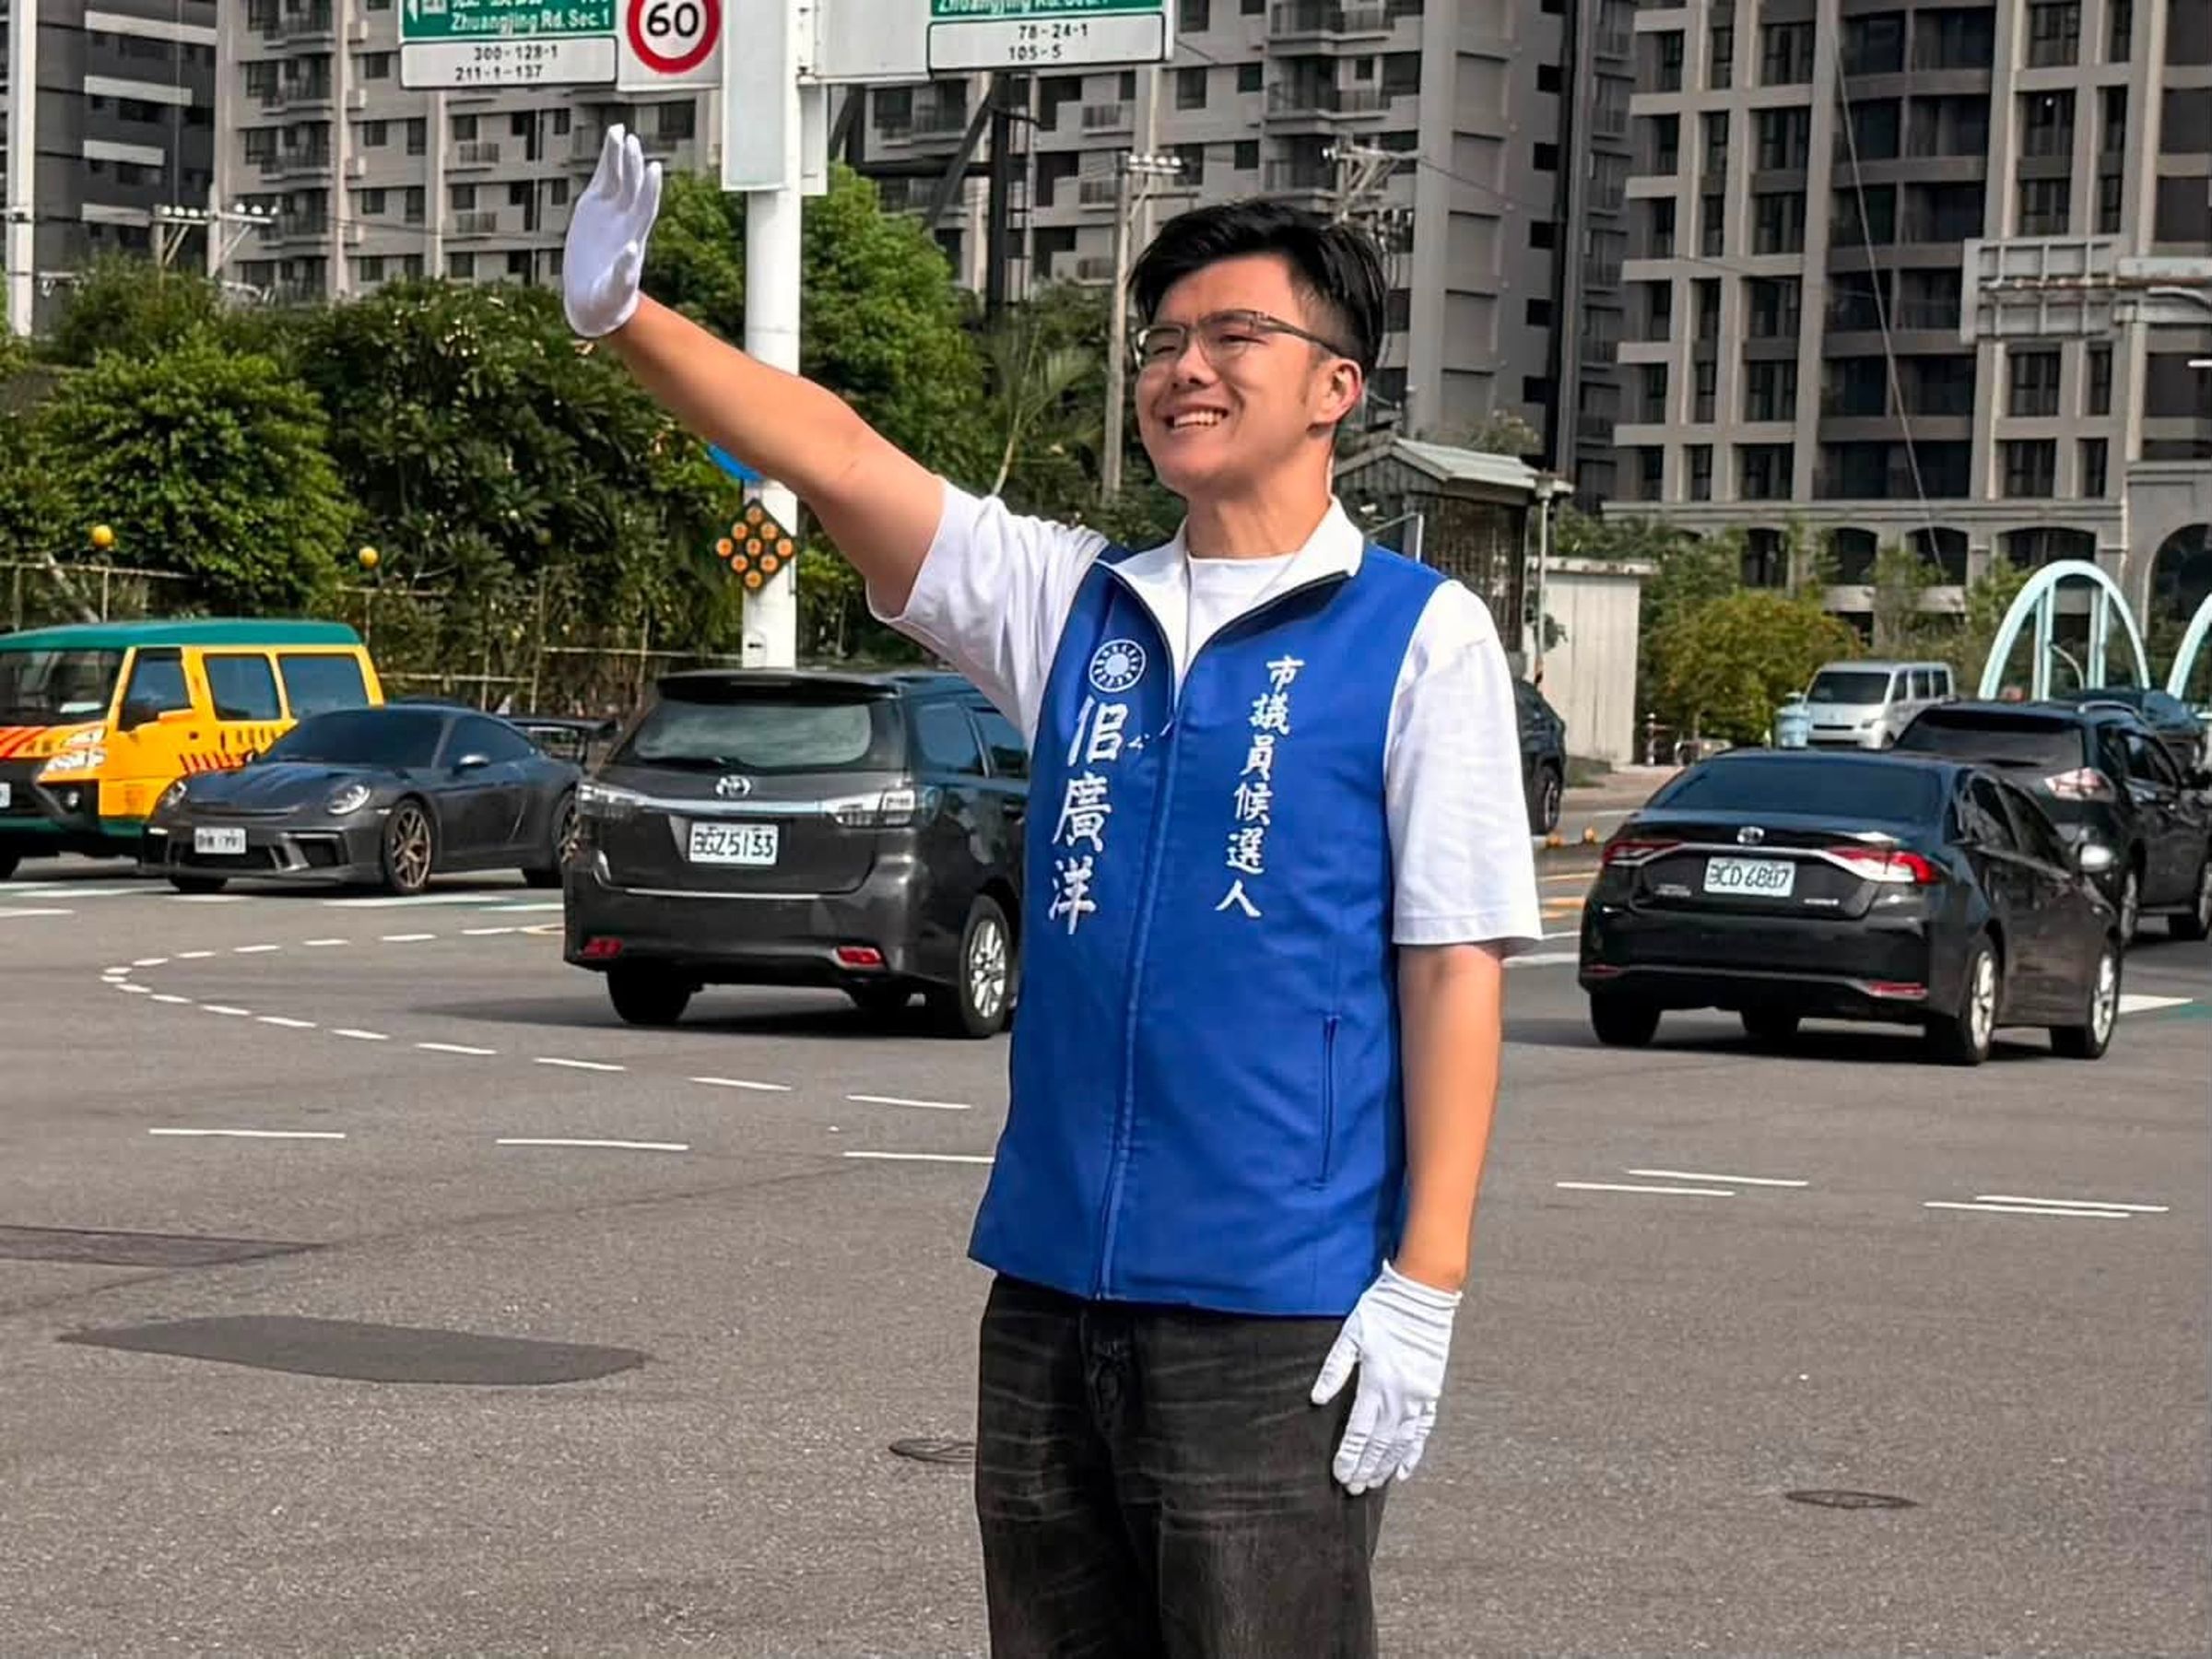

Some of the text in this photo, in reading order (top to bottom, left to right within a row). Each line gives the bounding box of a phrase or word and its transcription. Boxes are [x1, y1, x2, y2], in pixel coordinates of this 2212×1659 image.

[451, 12, 537, 36] Zhuangjing
[541, 9, 566, 29] Rd.
[647, 3, 700, 37] 60
[1008, 44, 1062, 60] 105-5
[1215, 655, 1305, 918] 市議員候選人
